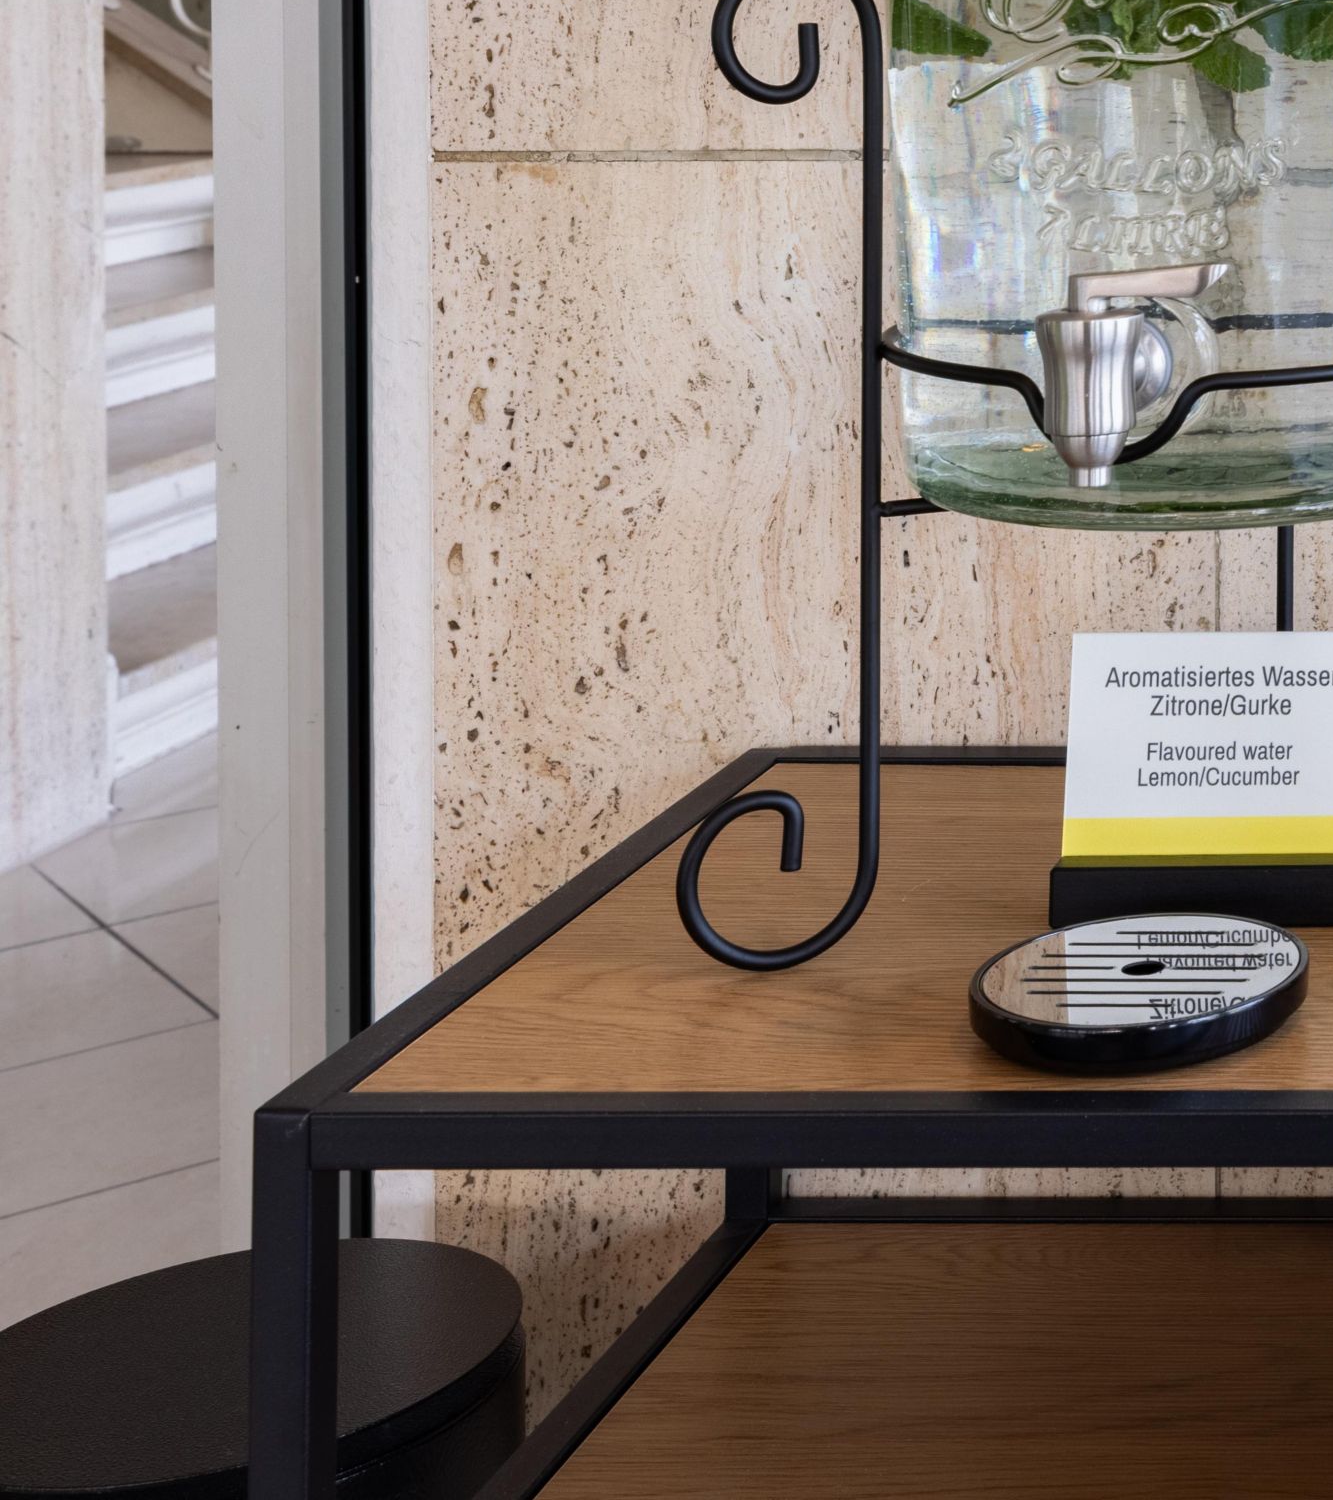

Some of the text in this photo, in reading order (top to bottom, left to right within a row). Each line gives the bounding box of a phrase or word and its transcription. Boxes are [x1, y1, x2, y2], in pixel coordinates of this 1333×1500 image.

[1105, 666, 1254, 687] Aromatisiertes
[1150, 694, 1291, 716] Zitrone/Gurke
[1147, 741, 1293, 761] Flavoured water
[1138, 766, 1300, 787] Lemon/Cucumber
